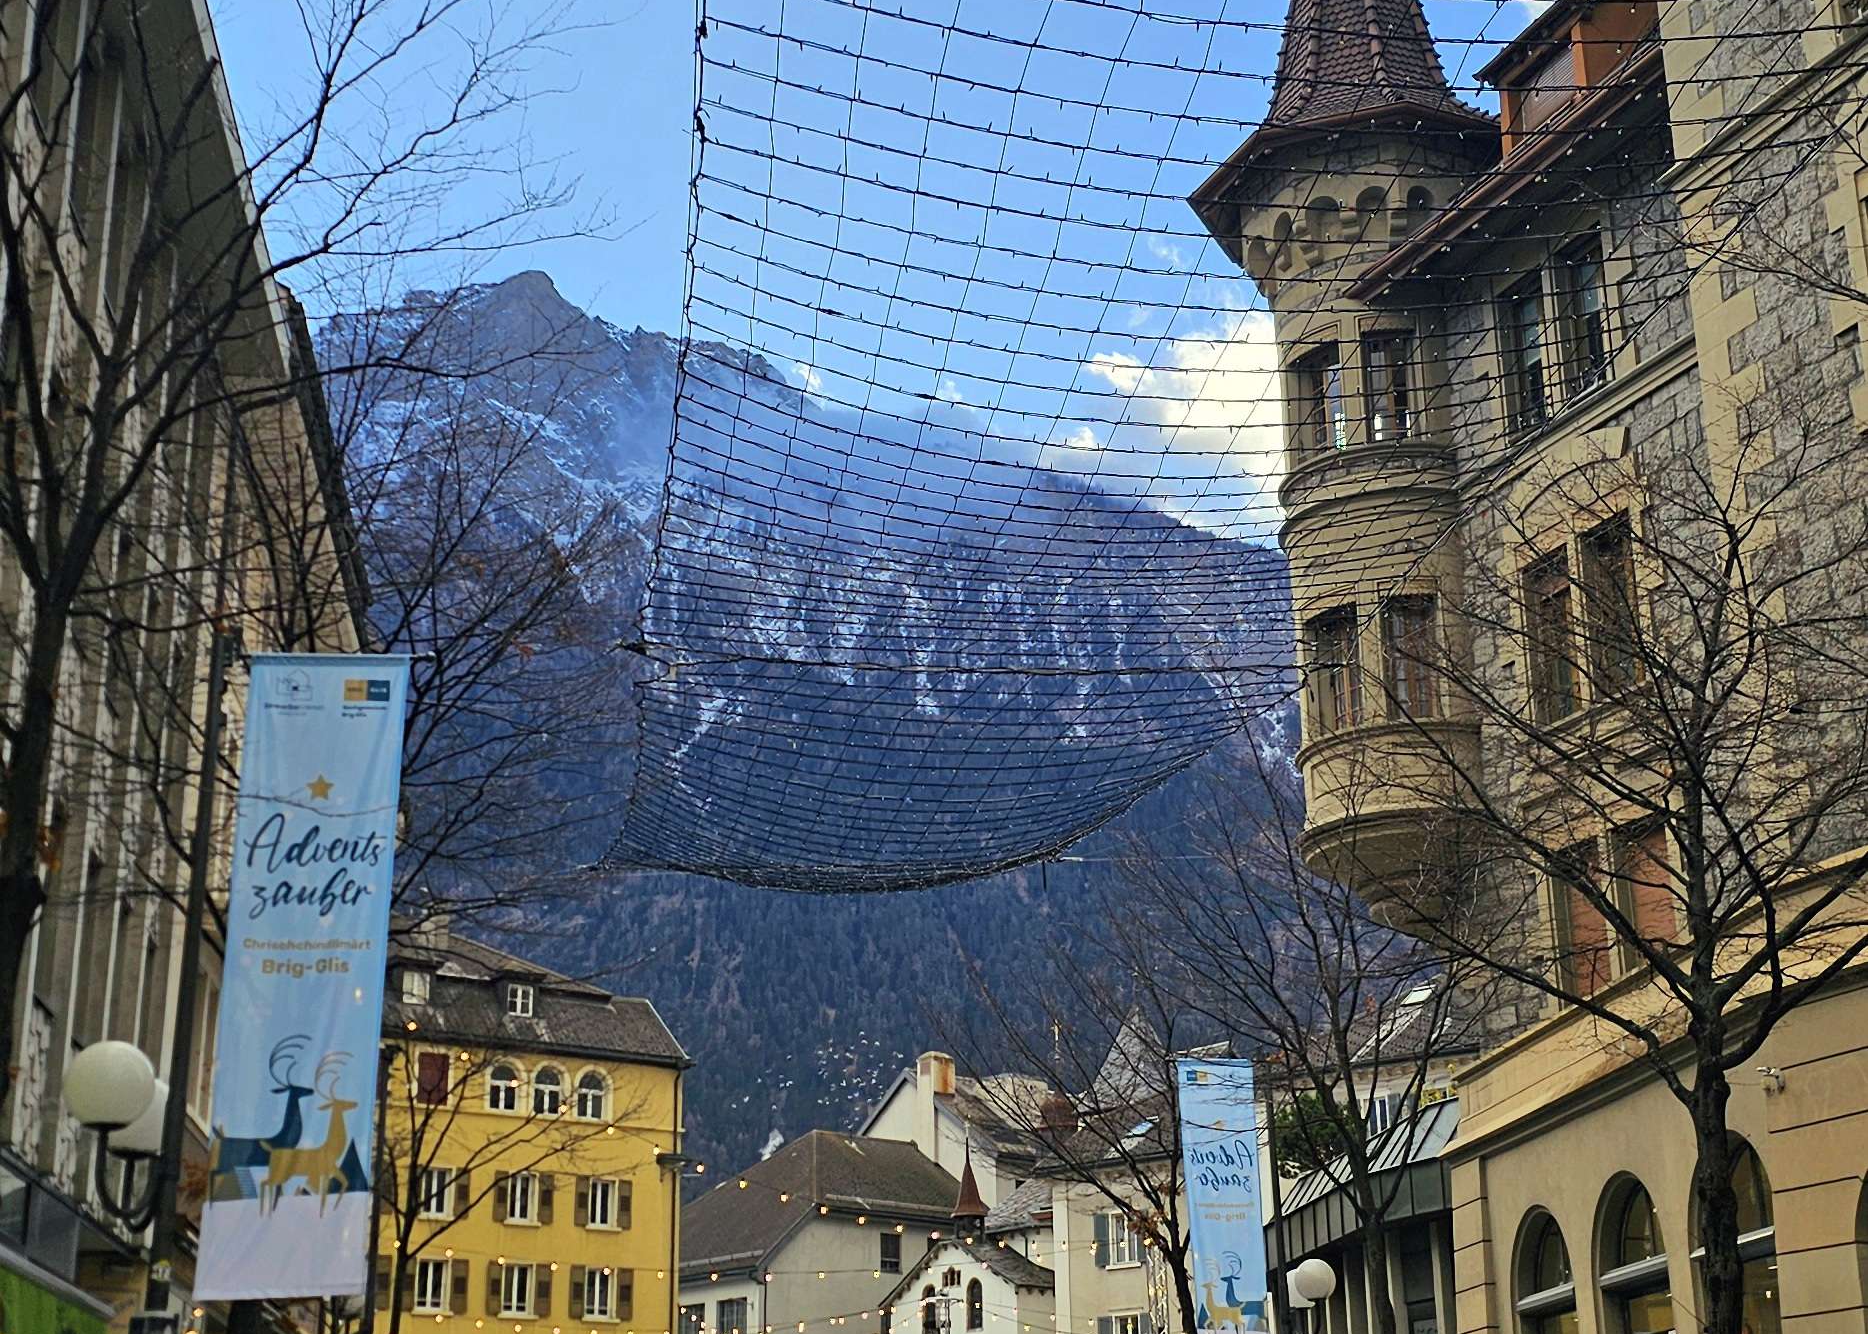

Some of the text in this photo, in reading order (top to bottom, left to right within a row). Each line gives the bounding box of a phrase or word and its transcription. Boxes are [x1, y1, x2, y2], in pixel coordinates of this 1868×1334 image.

[243, 812, 388, 874] Advents
[249, 867, 372, 920] zauber
[261, 957, 350, 979] Brig-Glis
